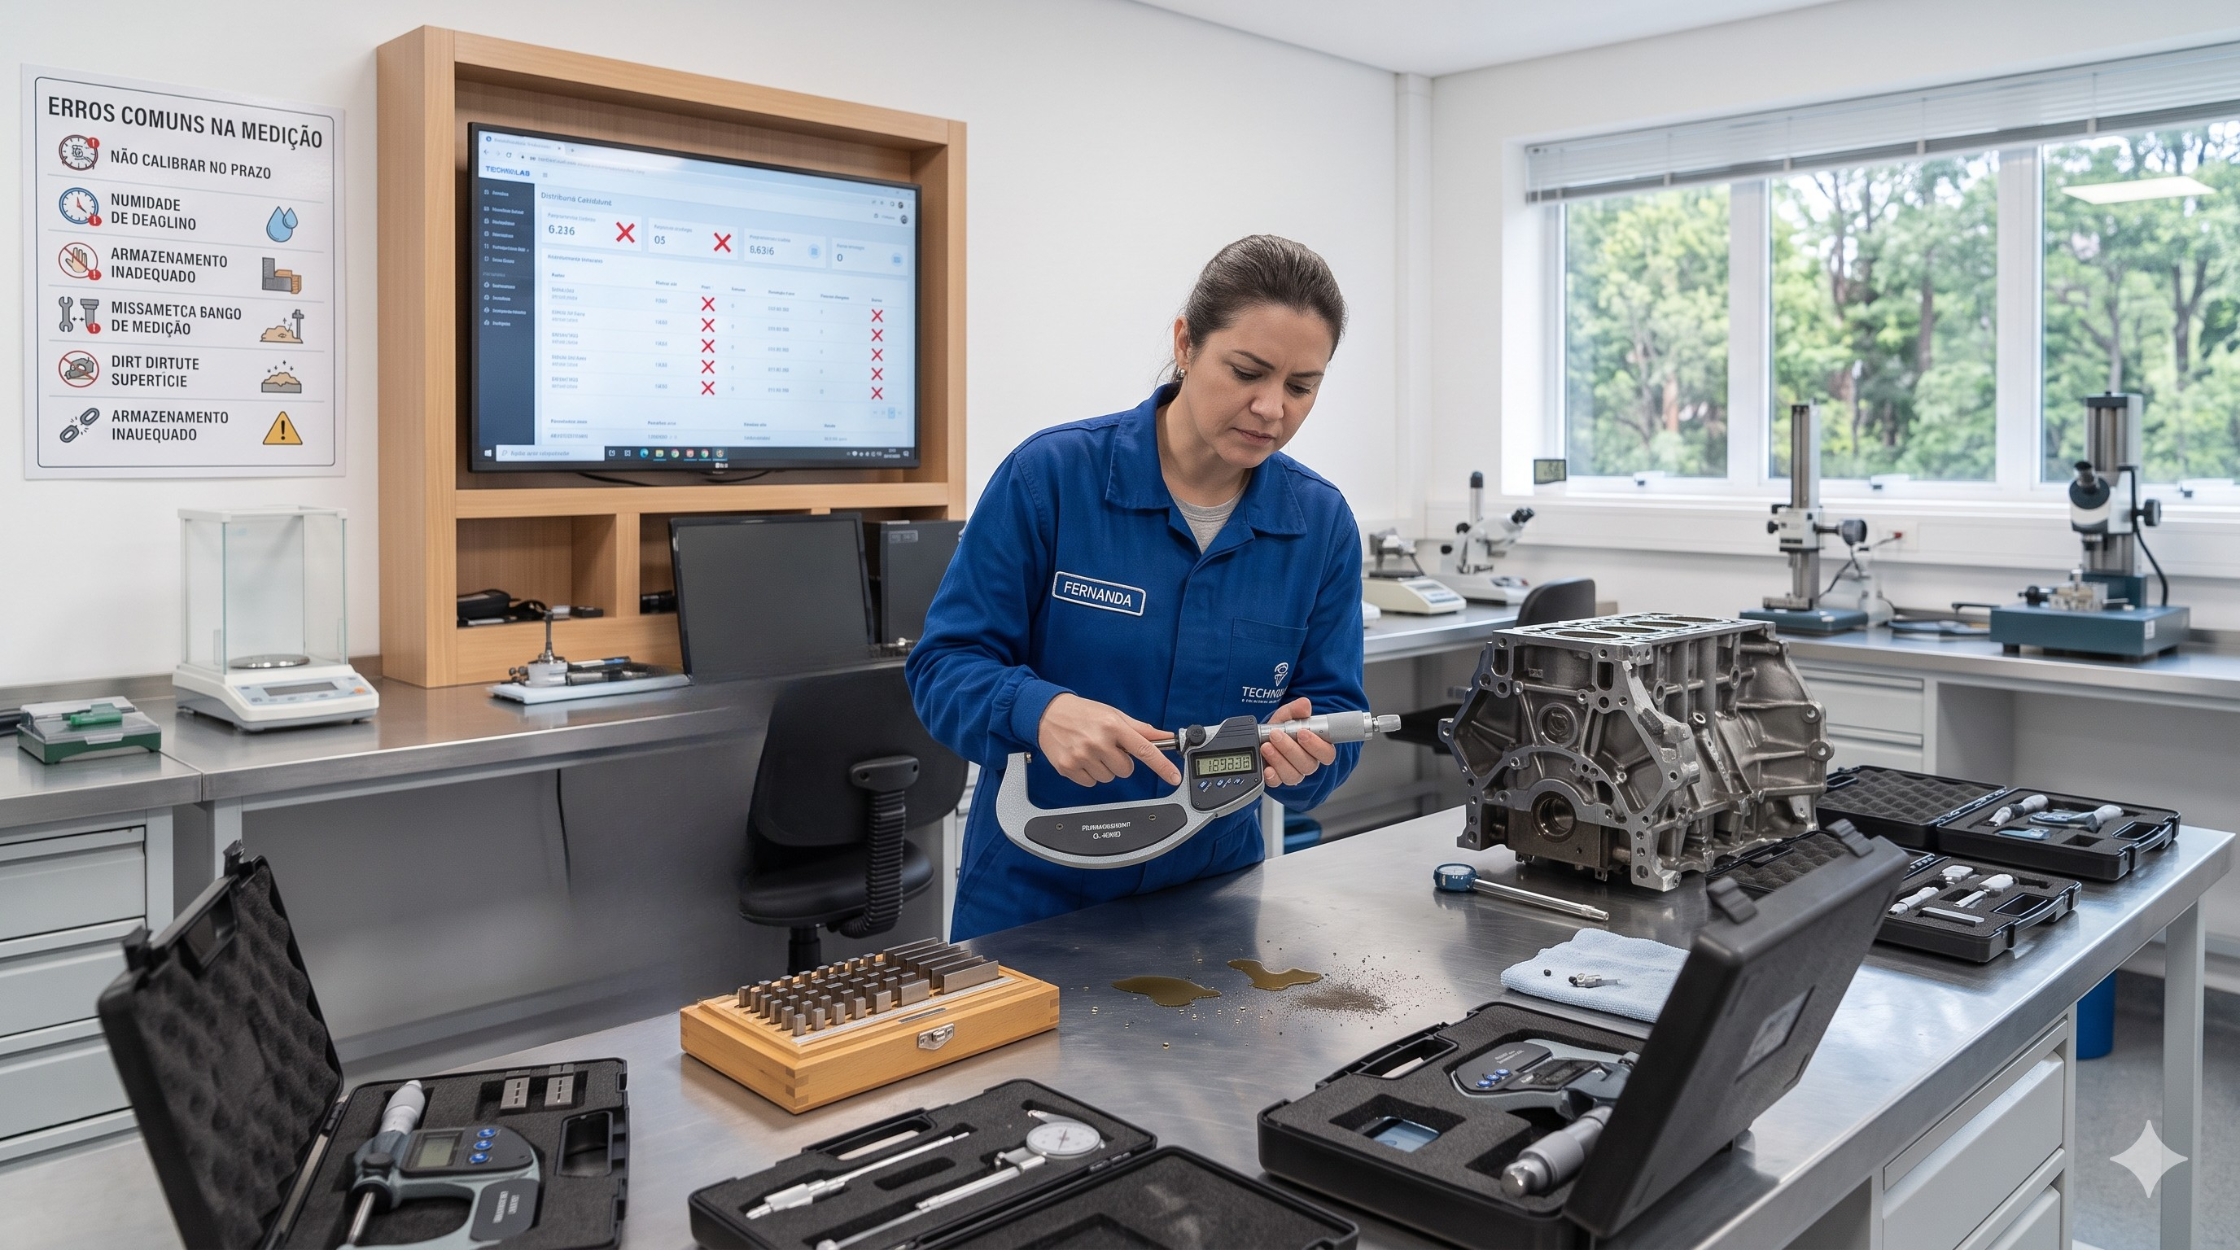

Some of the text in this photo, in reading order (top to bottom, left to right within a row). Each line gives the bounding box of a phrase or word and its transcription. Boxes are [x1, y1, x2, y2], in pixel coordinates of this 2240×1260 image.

[48, 96, 323, 150] ERROS COMUNS NA MEDIÇÃO
[110, 147, 271, 179] NÃO CALIBRAR NO PRAZO
[111, 193, 181, 212] NUMIDADE
[111, 211, 197, 231] DE DEAGLINO
[110, 247, 228, 268] ARMAZENAMENTO
[111, 265, 196, 283] INADEQUADO
[111, 301, 197, 318] MISSAMETCA
[111, 319, 191, 338] DE MEDIÇÃO
[111, 355, 200, 370] DIRT DIRTUTE
[111, 410, 229, 424] ARMAZENAMENTO
[112, 428, 197, 443] INAUEQUADO
[1063, 581, 1132, 608] FERNANDA
